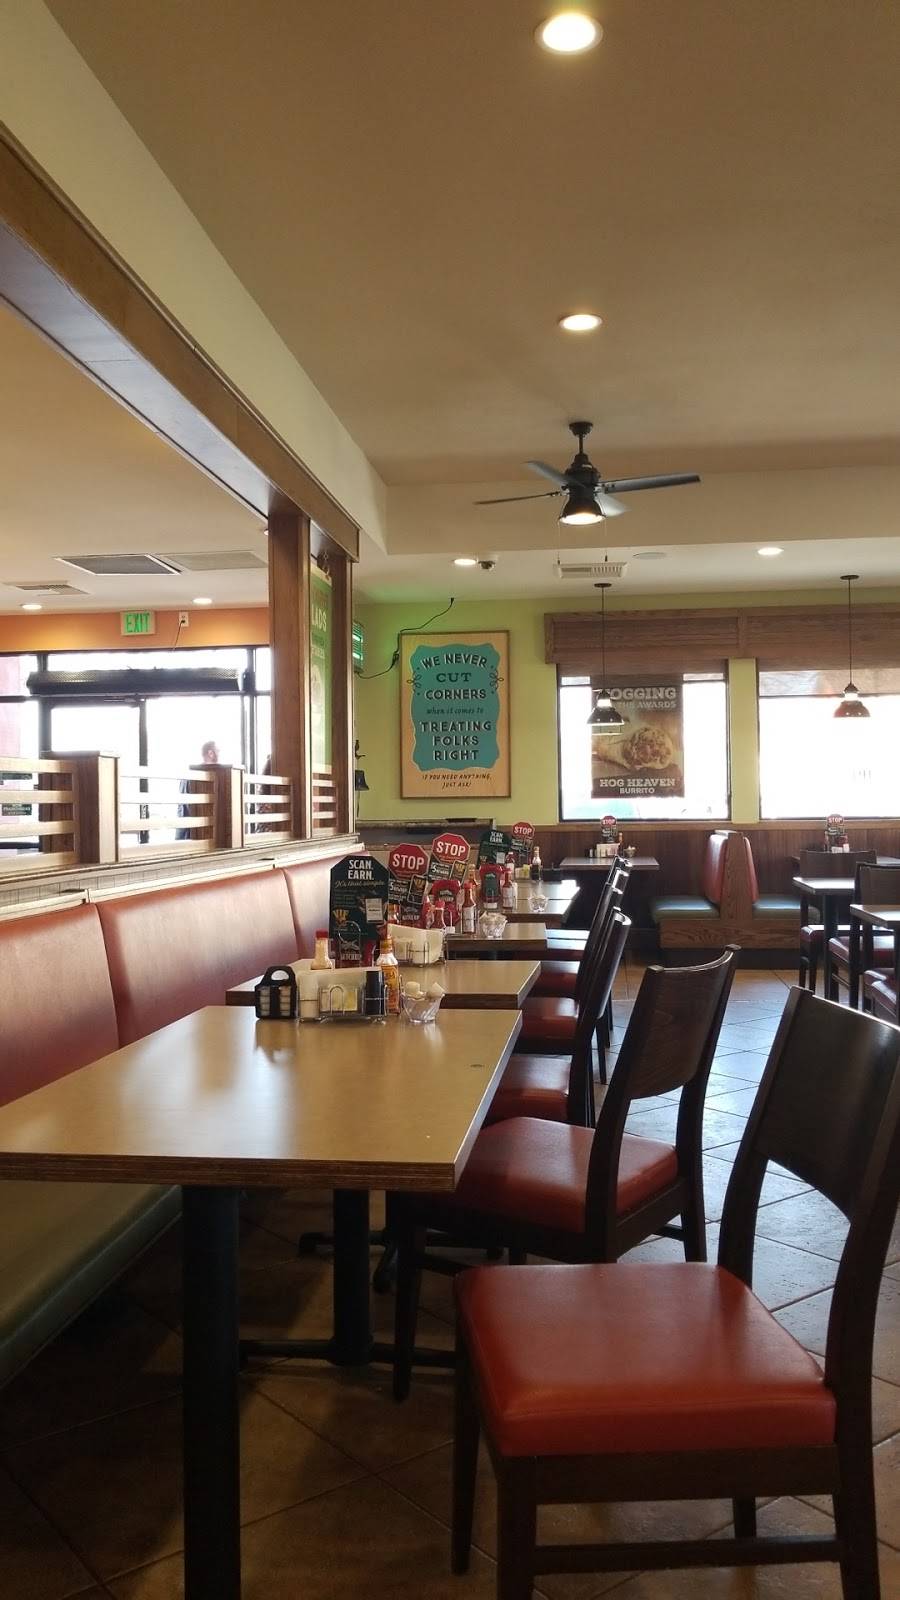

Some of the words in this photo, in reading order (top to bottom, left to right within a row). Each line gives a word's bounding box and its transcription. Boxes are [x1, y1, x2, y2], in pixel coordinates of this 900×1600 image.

[126, 613, 150, 633] EXIT
[421, 656, 440, 669] WE
[444, 653, 487, 668] NEVER
[436, 672, 471, 683] CUT
[424, 688, 487, 700] CORNERS
[597, 687, 677, 700] OGGING
[639, 701, 677, 709] AWARDS
[420, 720, 492, 732] TREATING
[432, 735, 480, 747] FOLKS
[432, 749, 480, 760] RIGHT
[600, 778, 625, 788] HOG
[627, 778, 676, 788] HEAVEN
[514, 826, 533, 835] STOP
[436, 841, 466, 857] STOP
[348, 859, 374, 870] SCAN.
[392, 853, 425, 871] STOP
[347, 870, 375, 880] EARN.
